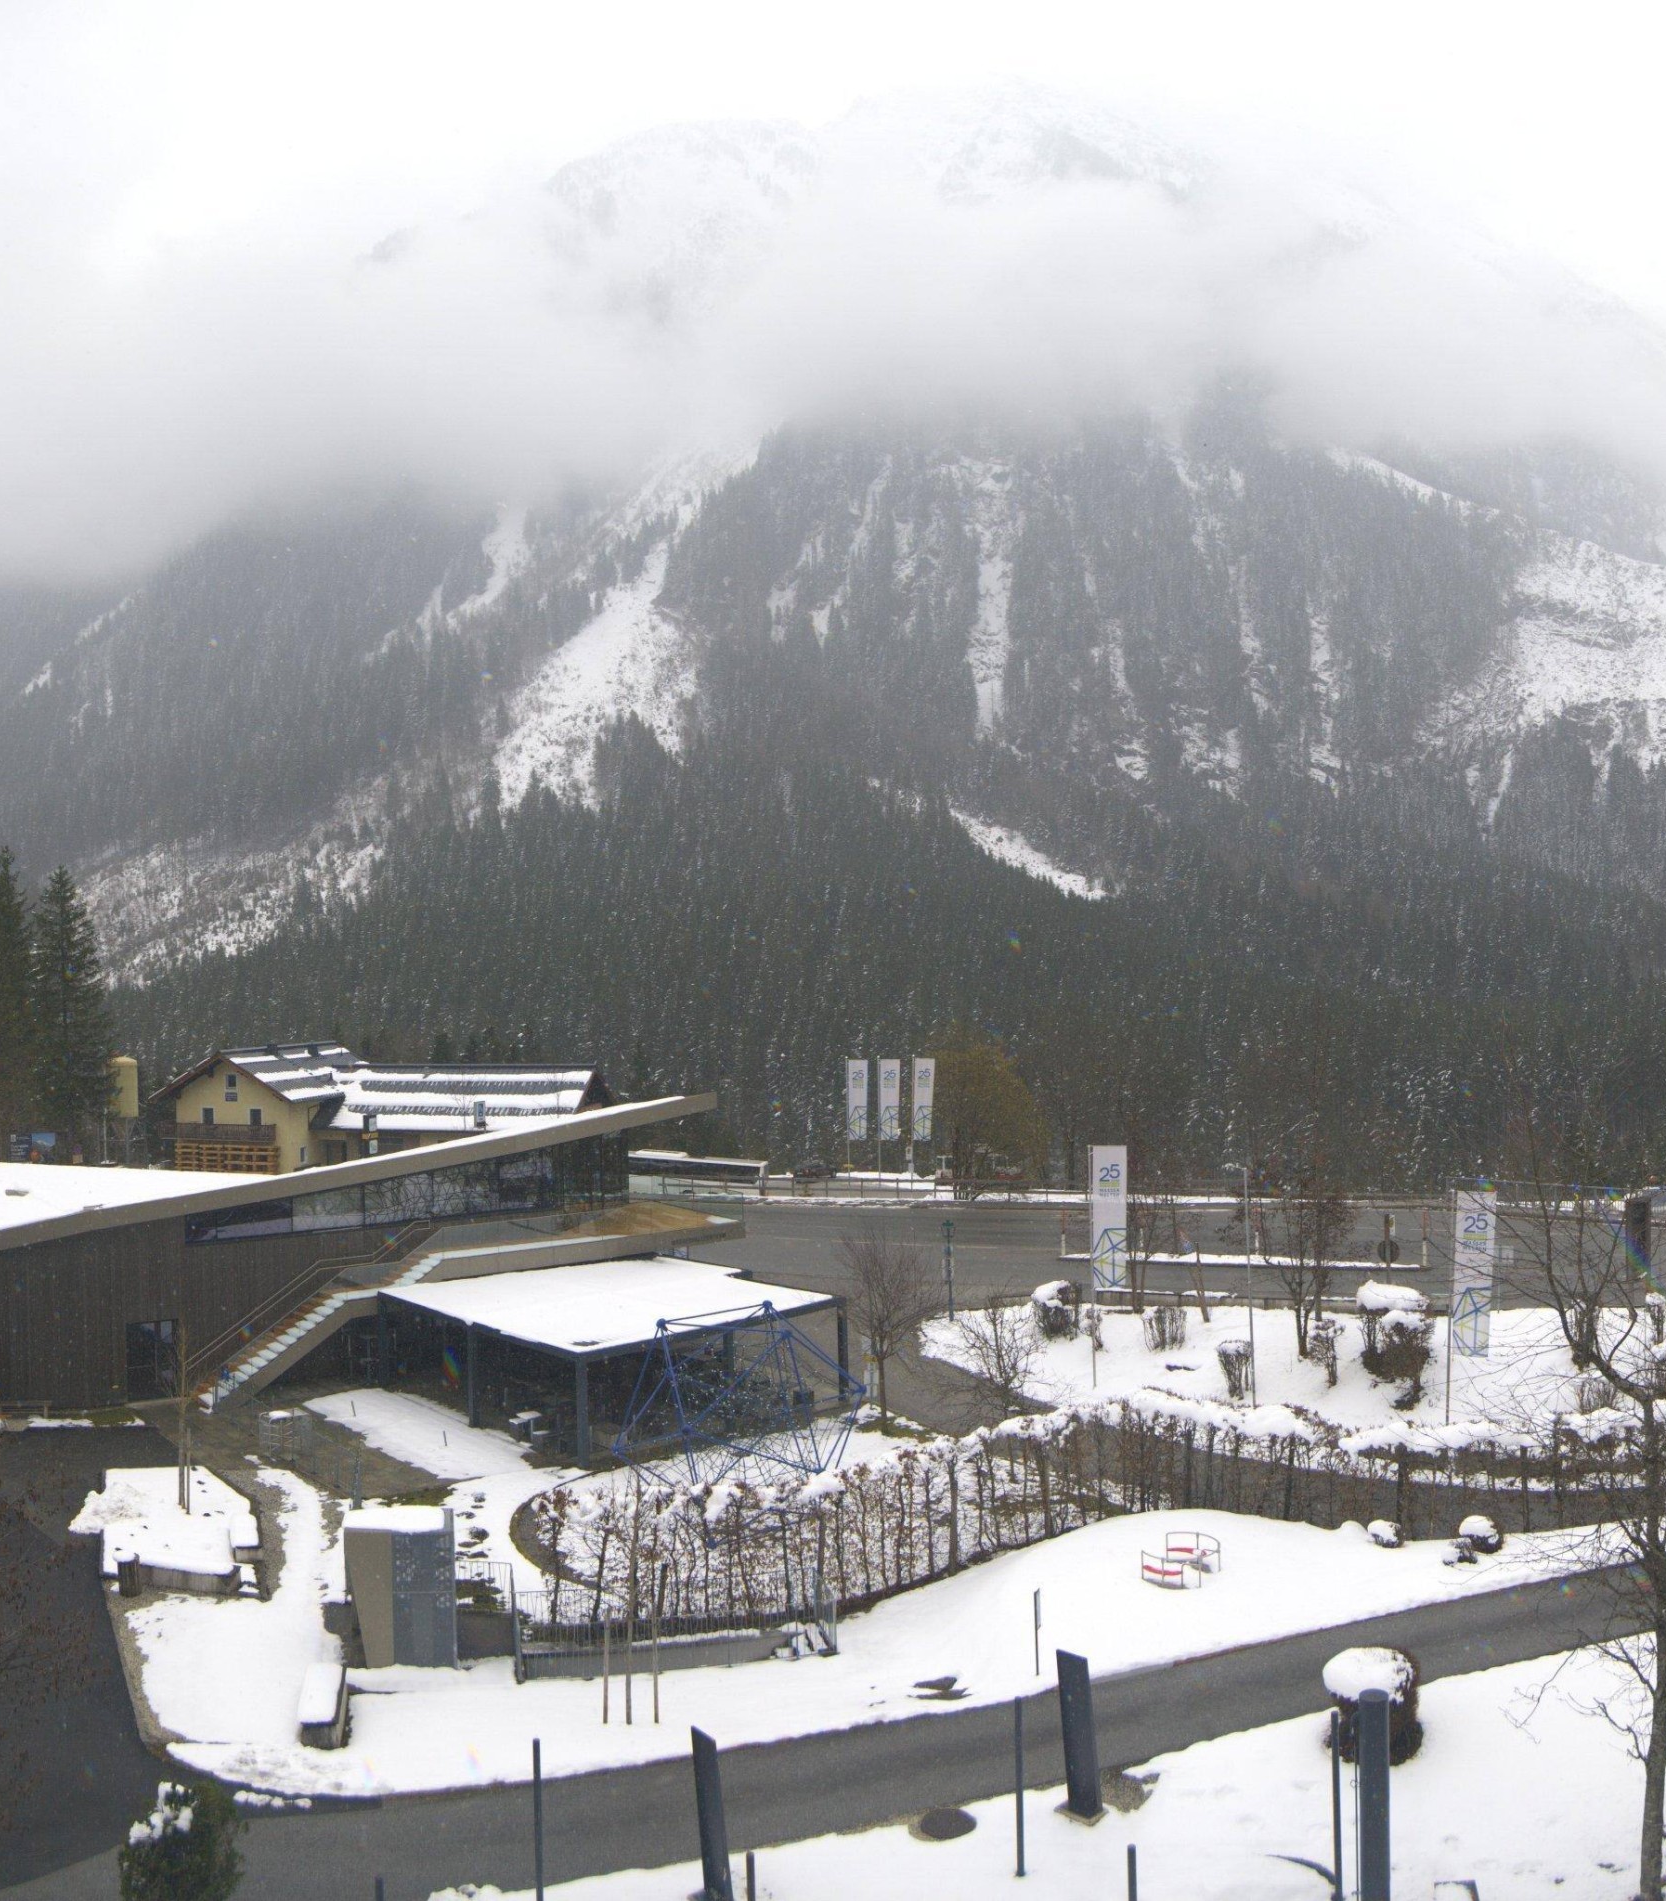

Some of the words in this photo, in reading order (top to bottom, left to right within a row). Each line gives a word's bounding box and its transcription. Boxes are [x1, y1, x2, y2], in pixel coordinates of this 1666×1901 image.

[852, 1070, 865, 1080] 25
[883, 1070, 896, 1080] 25
[918, 1068, 931, 1079] 25
[1099, 1163, 1121, 1182] 25
[1464, 1213, 1488, 1233] 25
